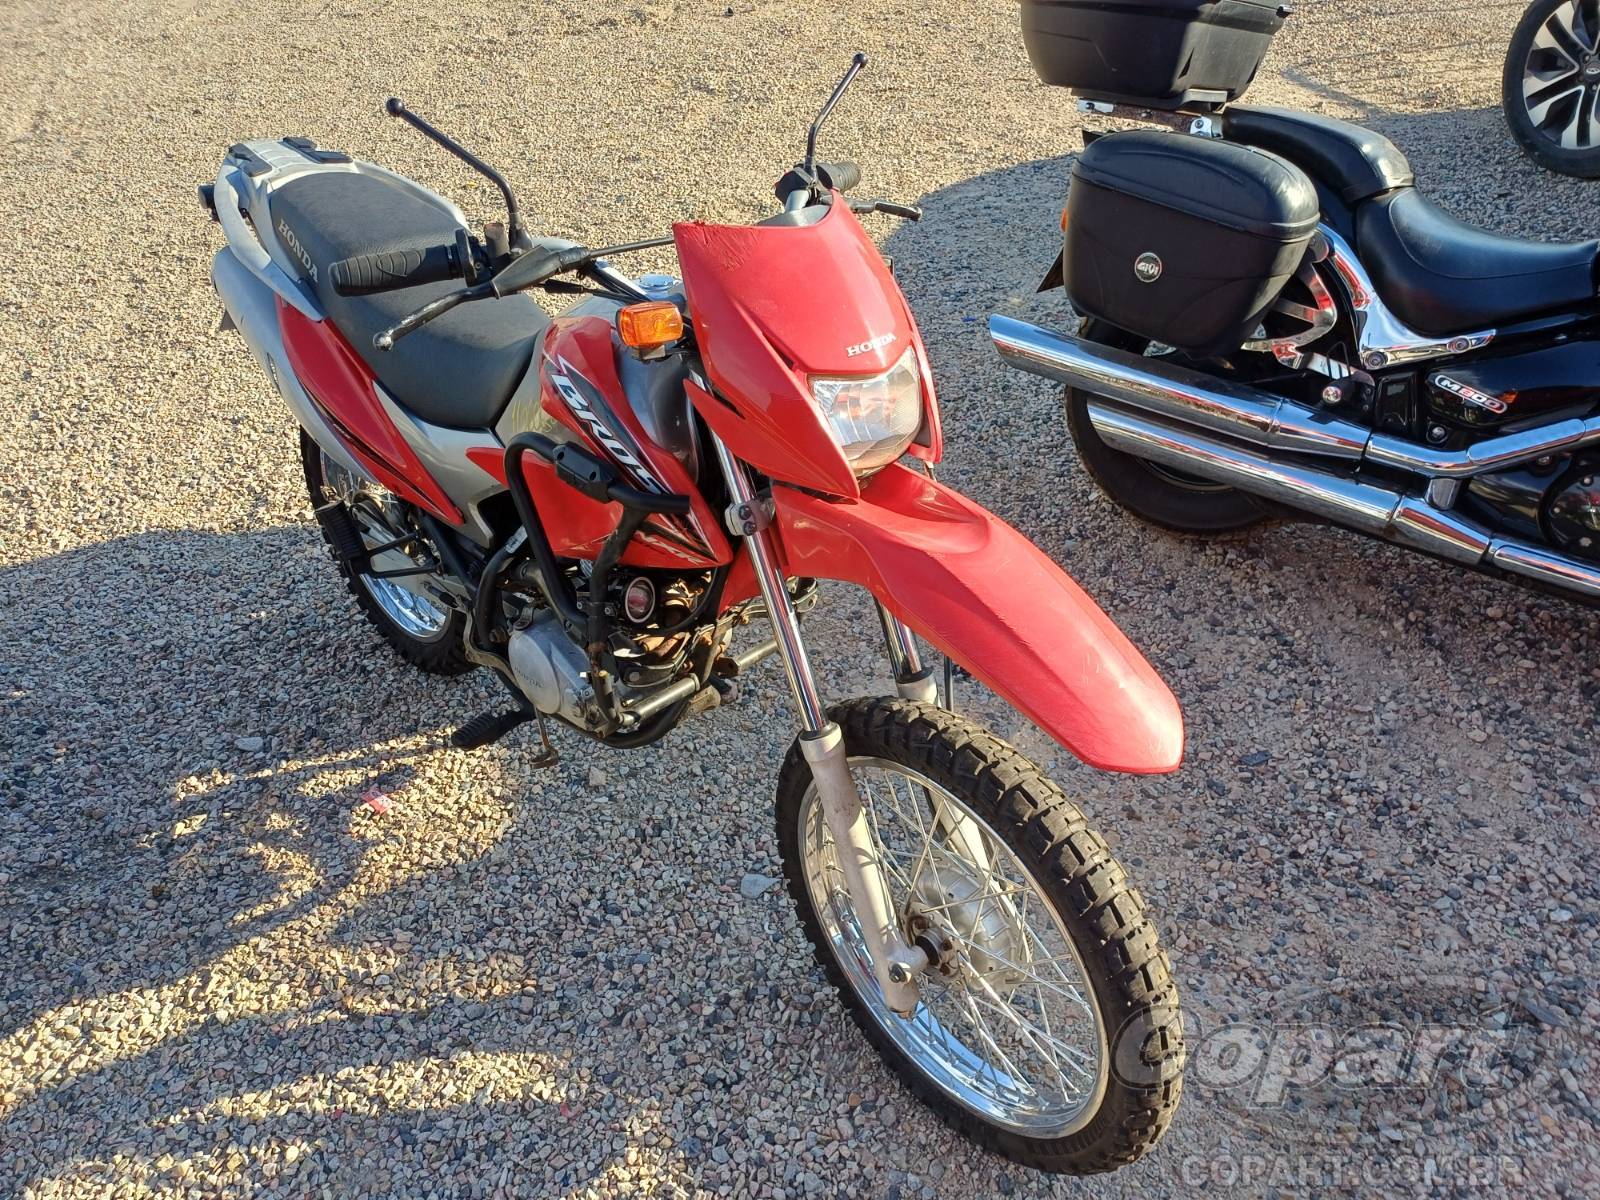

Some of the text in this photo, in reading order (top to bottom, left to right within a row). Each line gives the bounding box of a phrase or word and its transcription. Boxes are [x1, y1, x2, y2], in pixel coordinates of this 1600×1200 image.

[278, 218, 318, 283] HONDA
[845, 332, 897, 357] HONDA
[1440, 379, 1502, 409] M800
[551, 374, 674, 495] BROS
